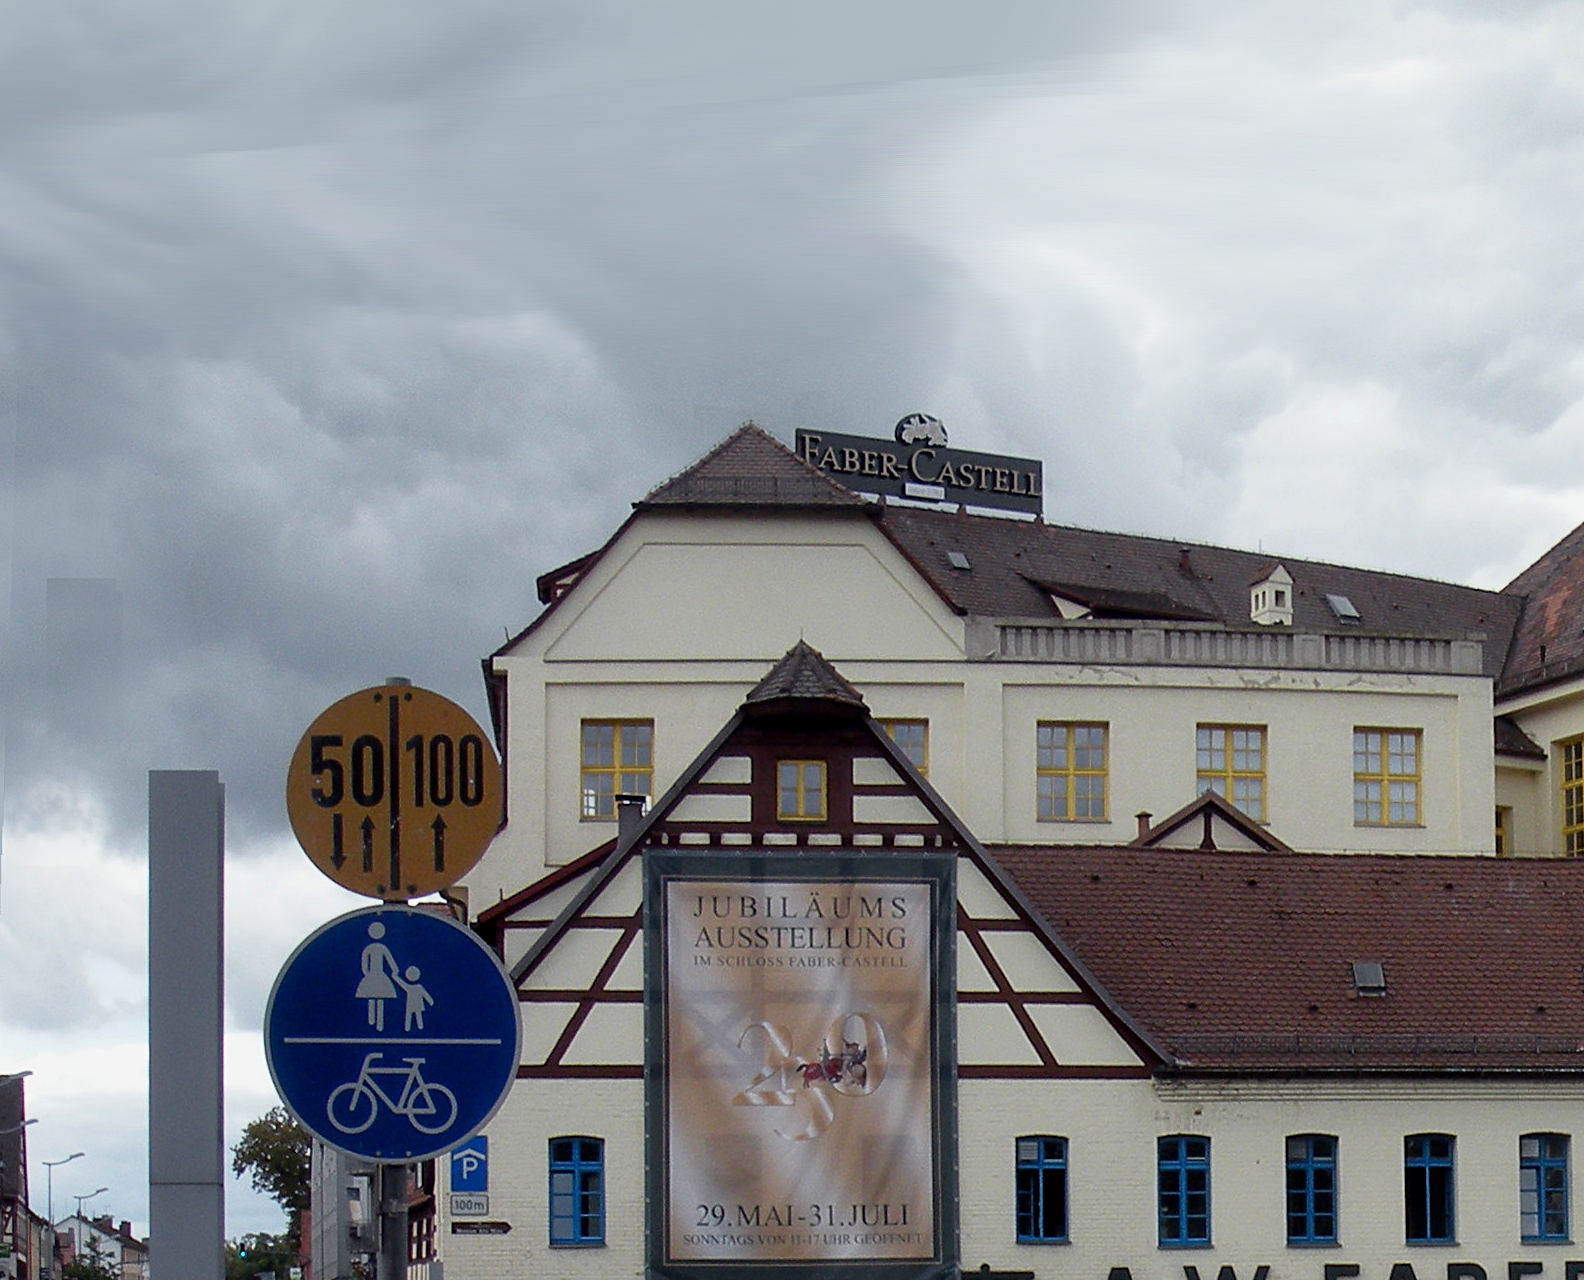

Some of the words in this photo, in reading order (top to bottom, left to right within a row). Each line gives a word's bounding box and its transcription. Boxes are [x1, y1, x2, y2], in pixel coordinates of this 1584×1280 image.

[802, 434, 1042, 497] FABER-CASTELL
[311, 735, 384, 808] 50
[406, 734, 483, 807] 100
[694, 892, 907, 919] JUBILÄUMS
[694, 927, 906, 949] AUSSTELLUNG
[694, 955, 711, 967] IM
[717, 955, 784, 967] SCHLOSS
[789, 955, 907, 968] FABER-CASTELL
[463, 1157, 479, 1180] P
[683, 1234, 754, 1246] SONNTAGS
[757, 1234, 786, 1246] VON
[822, 1234, 851, 1246] UHR
